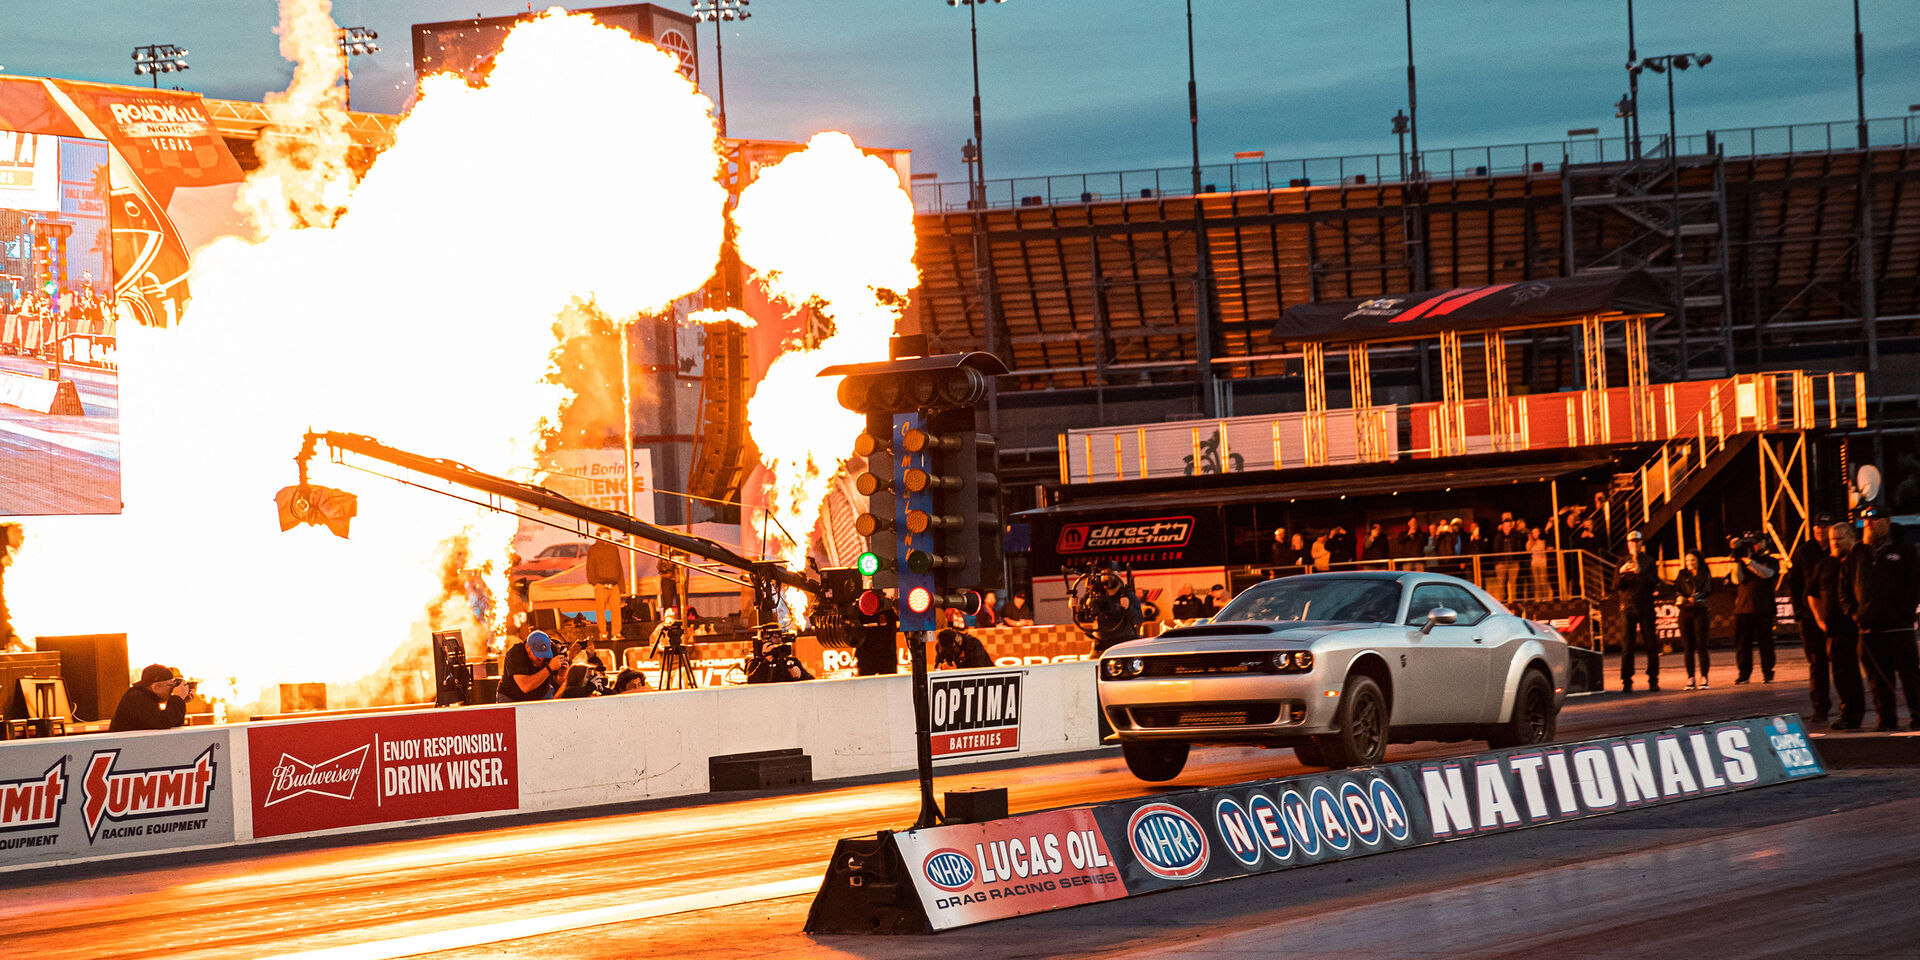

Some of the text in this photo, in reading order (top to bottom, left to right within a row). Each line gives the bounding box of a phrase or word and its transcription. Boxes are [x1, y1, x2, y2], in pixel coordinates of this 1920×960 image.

[109, 103, 206, 124] ROADKILL
[151, 138, 192, 151] VEGAS
[592, 462, 639, 475] Borin?
[1088, 535, 1182, 547] connection
[1090, 523, 1167, 538] direct
[934, 683, 1017, 726] OPTIMA
[383, 732, 508, 761] ENJOY RESPONSIBLY.
[949, 732, 1002, 750] BATTERIES
[272, 763, 361, 791] Budweiser
[384, 757, 509, 797] DRINK WISER.
[1421, 727, 1758, 838] NATIONALS
[83, 749, 214, 840] SUMMIT
[102, 818, 208, 840] RACING EQUIPMENT
[1219, 786, 1407, 858] NEVADA
[1138, 814, 1200, 866] NHRA
[929, 858, 973, 886] NHRA
[974, 833, 1064, 884] LUCAS
[935, 872, 1118, 909] DRAG RACING SERIES
